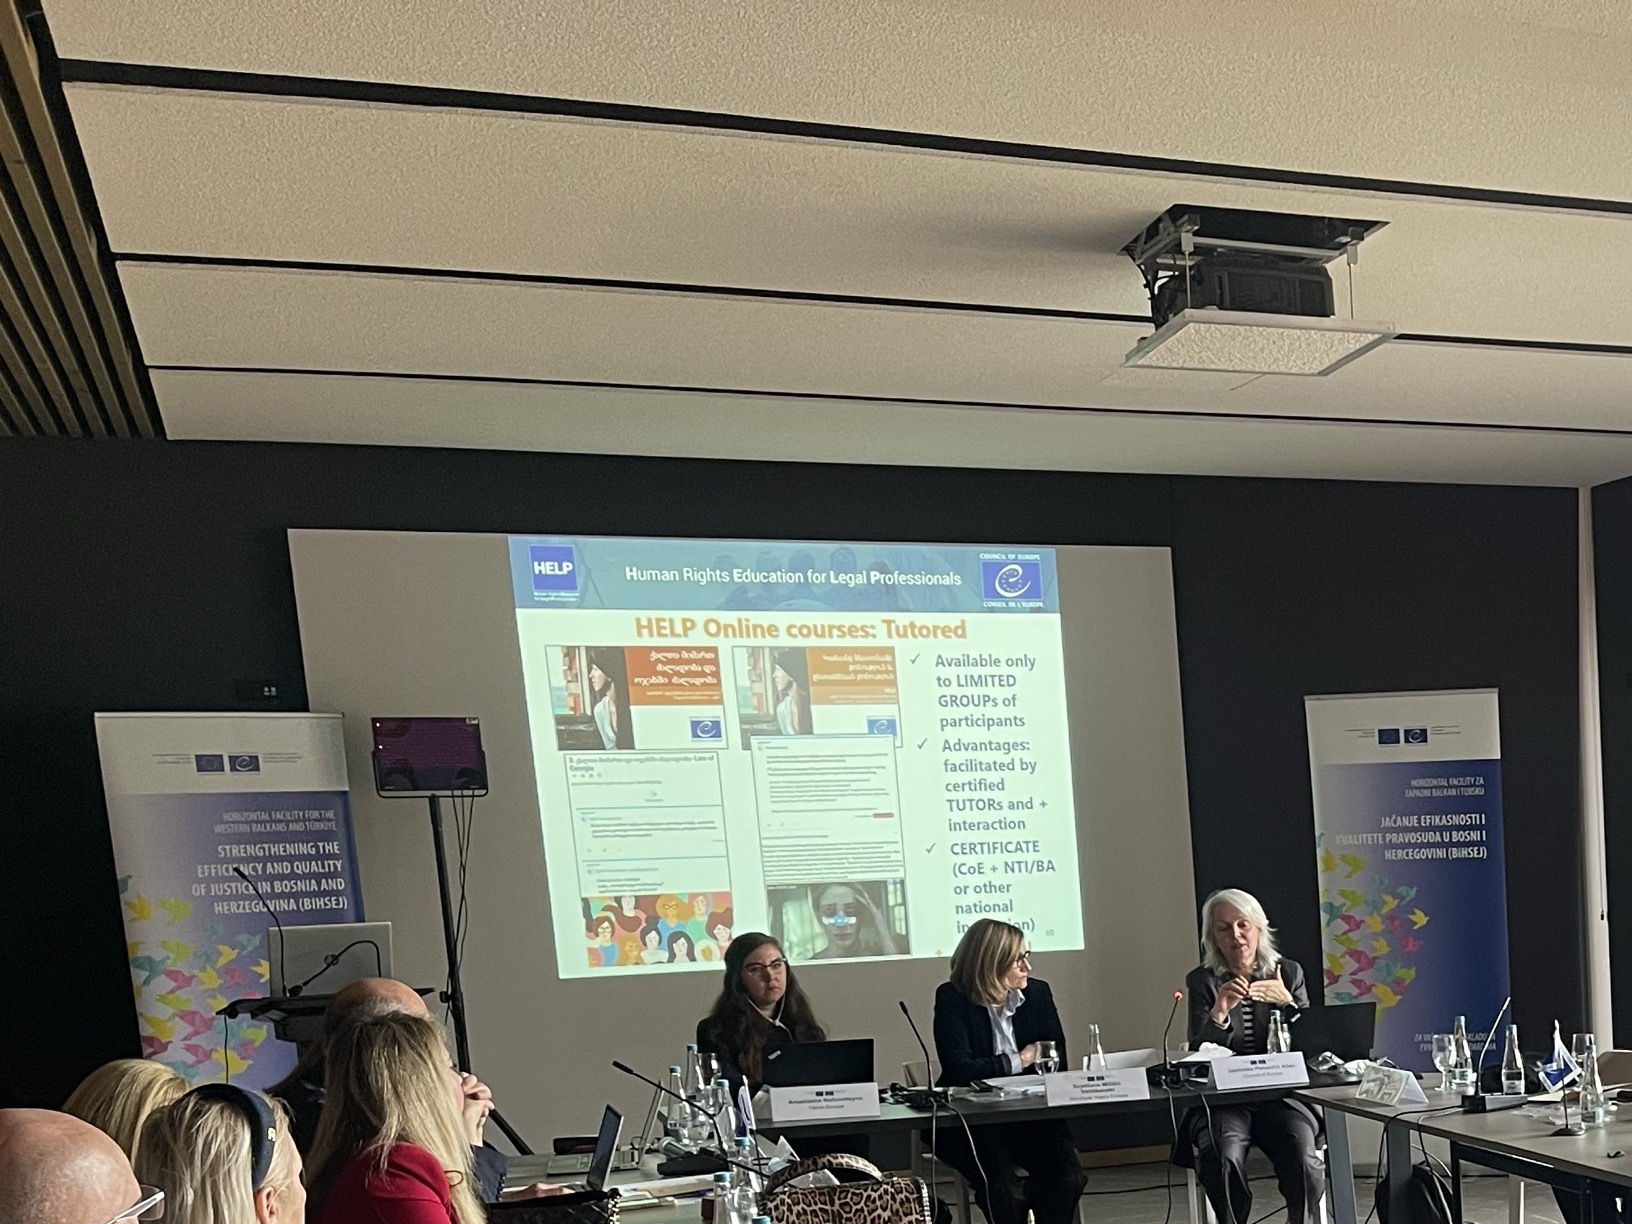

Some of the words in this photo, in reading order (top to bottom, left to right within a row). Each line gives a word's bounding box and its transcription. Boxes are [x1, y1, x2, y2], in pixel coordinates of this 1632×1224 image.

[533, 561, 574, 575] HELP
[625, 566, 680, 582] Human
[682, 567, 730, 586] Rights
[733, 568, 804, 584] Education
[807, 569, 826, 584] for
[830, 570, 867, 587] Legal
[870, 571, 962, 586] Professionals
[634, 617, 696, 638] HELP
[703, 618, 779, 638] Online
[786, 620, 877, 640] courses:
[881, 618, 967, 640] Tutored
[935, 653, 1001, 668] Available
[1006, 654, 1036, 671] only
[936, 676, 952, 688] to
[957, 674, 1016, 687] LIMITED
[938, 694, 998, 708] GROUPs
[1002, 694, 1017, 707] of
[940, 714, 1025, 731] participants
[942, 738, 1030, 755] Advantages:
[943, 758, 1015, 772] facilitated
[1020, 758, 1037, 774] by
[945, 778, 1005, 792] certified
[1411, 778, 1448, 787] HORIZONTAL
[1450, 777, 1475, 786] FACILITY
[1476, 777, 1484, 785] ZA
[1405, 789, 1431, 797] ZAPADNI
[1432, 788, 1457, 797] BALKAN
[1461, 787, 1484, 795] TURSKU
[946, 798, 1003, 812] TUTORs
[1008, 797, 1033, 810] and
[222, 811, 270, 822] HORIZONTAL
[271, 810, 304, 820] FACILITY
[305, 810, 320, 819] FOR
[321, 810, 335, 819] THE
[1421, 814, 1480, 826] EFIKASNOSTI
[1482, 814, 1485, 824] I
[213, 823, 250, 833] WESTERN
[252, 822, 288, 832] BALKANS
[288, 822, 305, 831] AND
[948, 817, 1026, 832] interaction
[1336, 833, 1383, 845] KVALITETE
[1443, 831, 1450, 842] U
[1452, 831, 1481, 842] BOSNI
[1482, 830, 1486, 841] I
[218, 843, 316, 858] STRENGTHENING
[317, 842, 340, 854] THE
[950, 840, 1040, 855] CERTIFICATE
[1385, 848, 1447, 860] HERCEGOVINI
[266, 862, 291, 875] AND
[294, 860, 342, 874] QUALITY
[953, 863, 985, 878] (CoE
[990, 865, 998, 873] +
[1004, 860, 1056, 874] NTI/BA
[192, 884, 207, 896] OF
[210, 882, 255, 896] JUSTICE
[258, 882, 271, 893] IN
[274, 880, 318, 892] BOSNIA
[320, 878, 345, 890] AND
[954, 884, 969, 895] or
[973, 881, 1012, 894] other
[214, 899, 297, 914] HERZEGOVINA
[955, 899, 1013, 914] national
